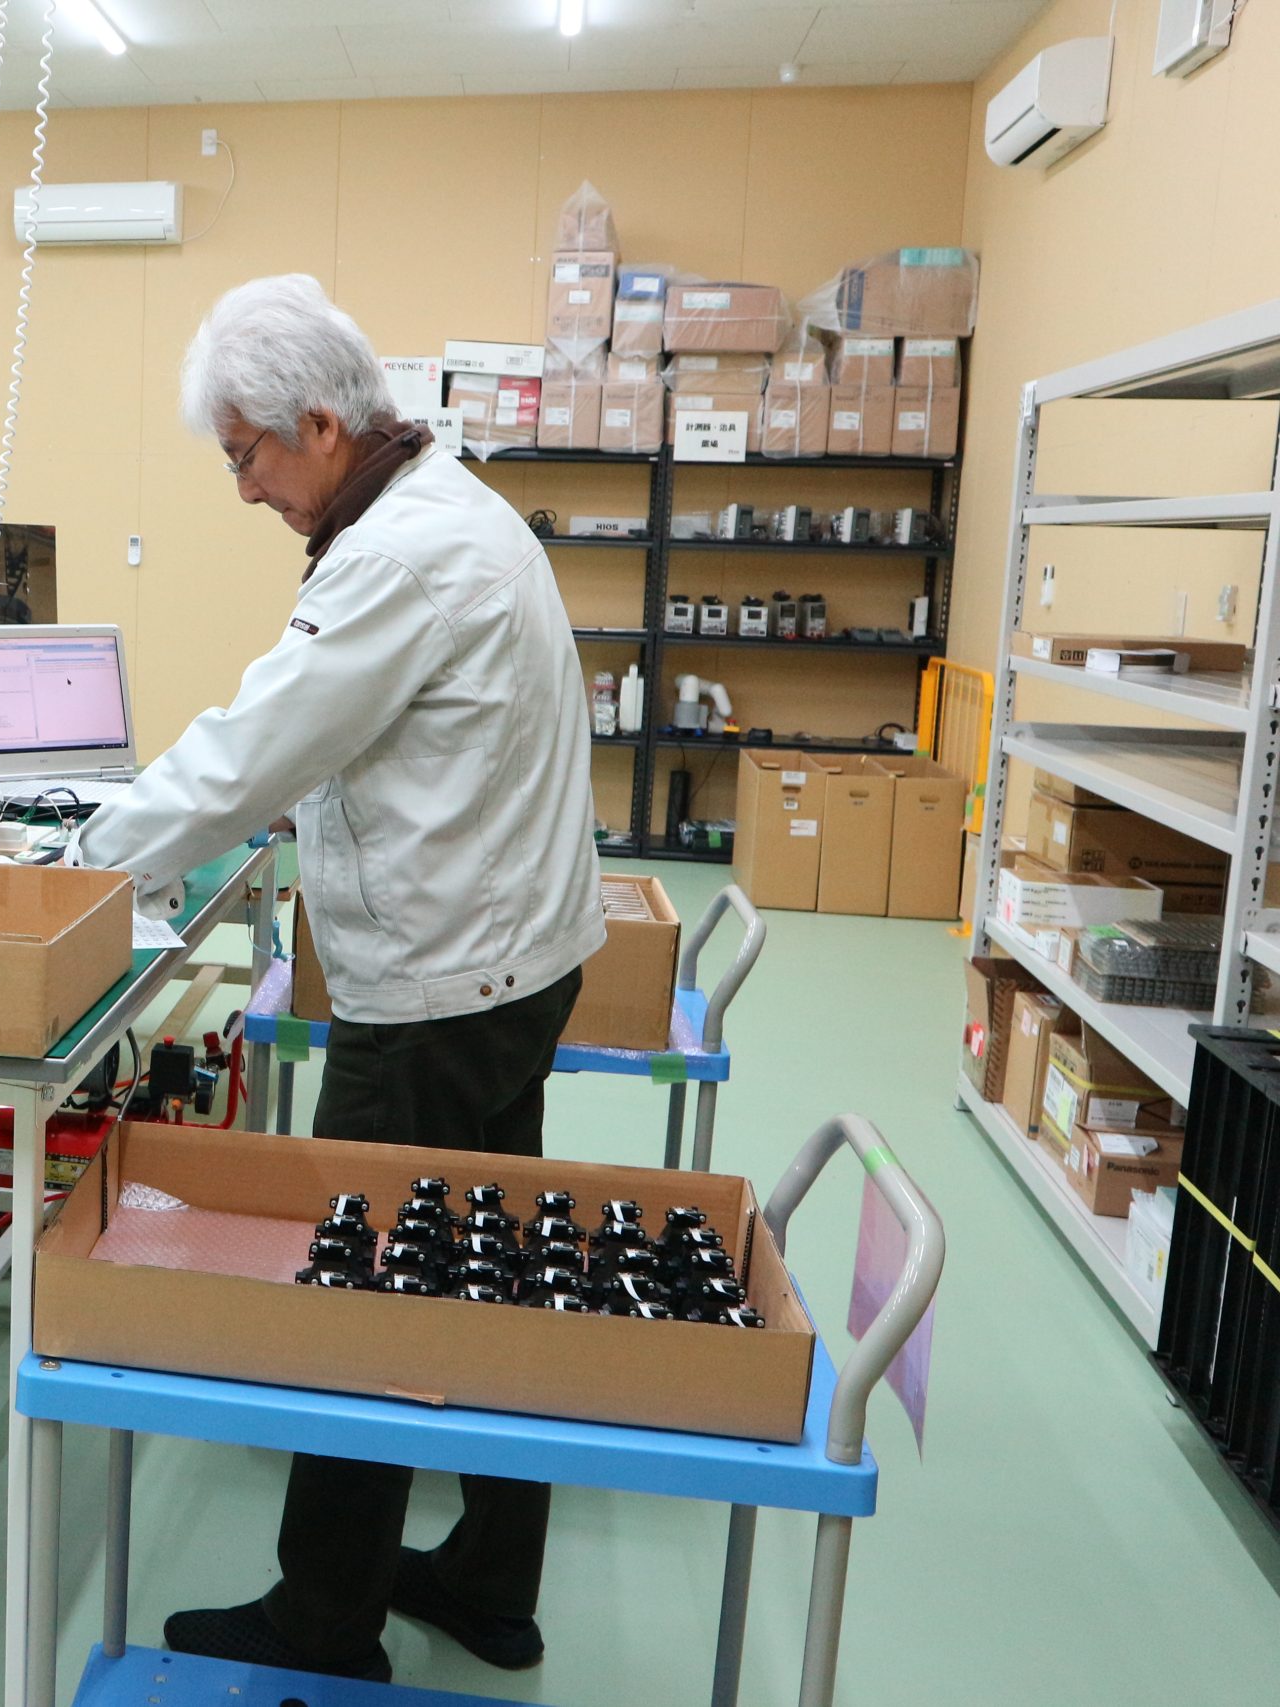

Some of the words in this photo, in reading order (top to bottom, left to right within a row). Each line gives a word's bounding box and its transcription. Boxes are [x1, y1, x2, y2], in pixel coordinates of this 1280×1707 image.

[384, 362, 424, 371] KEYENCE
[596, 522, 619, 531] HIOS
[1107, 1161, 1160, 1176] Panasonic
